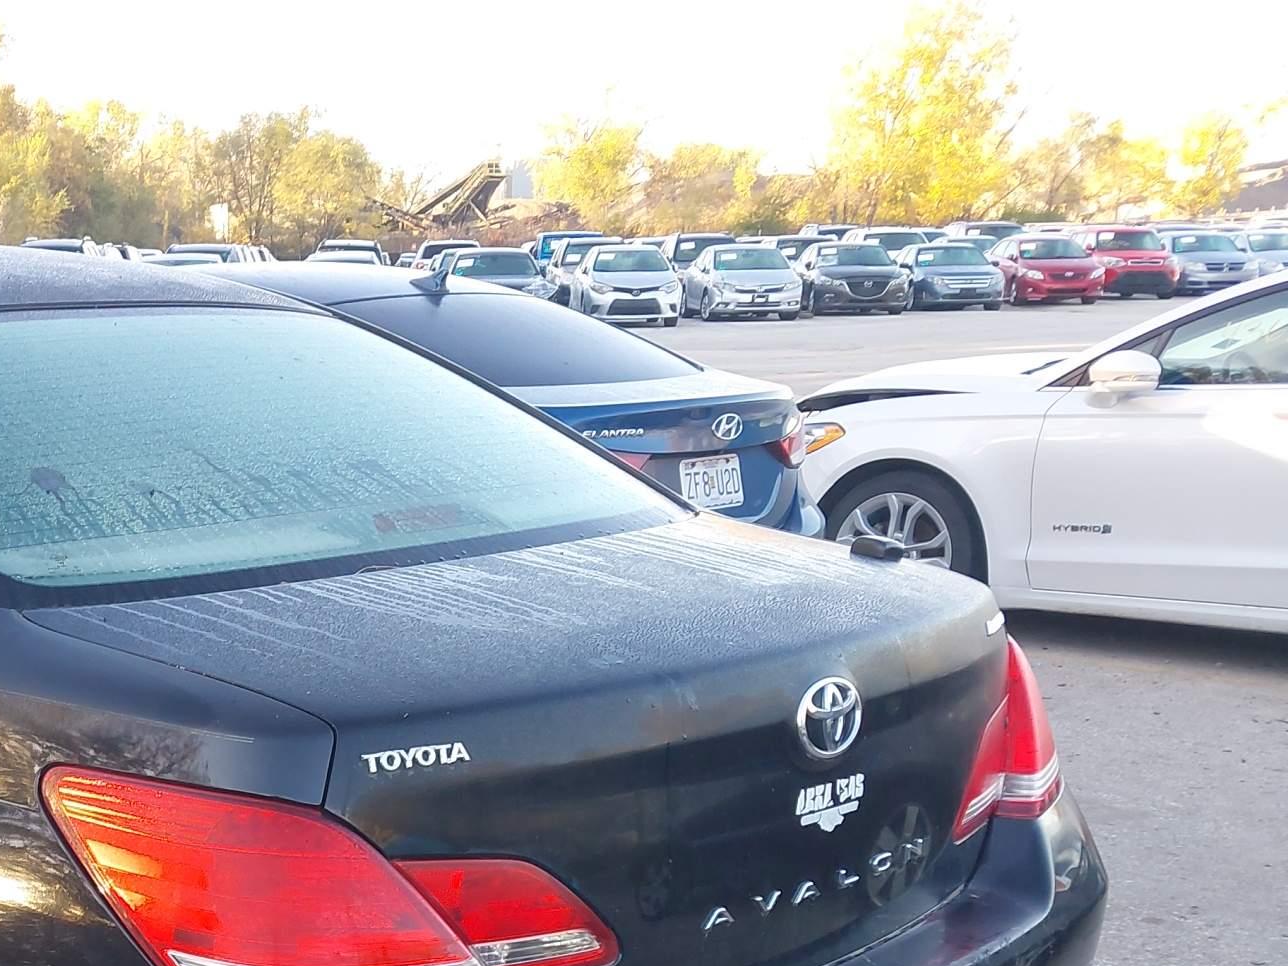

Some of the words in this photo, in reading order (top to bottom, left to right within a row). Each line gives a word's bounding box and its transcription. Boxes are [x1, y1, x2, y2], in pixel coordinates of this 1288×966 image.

[684, 470, 712, 500] ZF8
[715, 467, 741, 496] U2D
[1052, 524, 1102, 533] HYBRID
[360, 742, 472, 774] TOYOTA
[701, 837, 925, 932] AVALON
